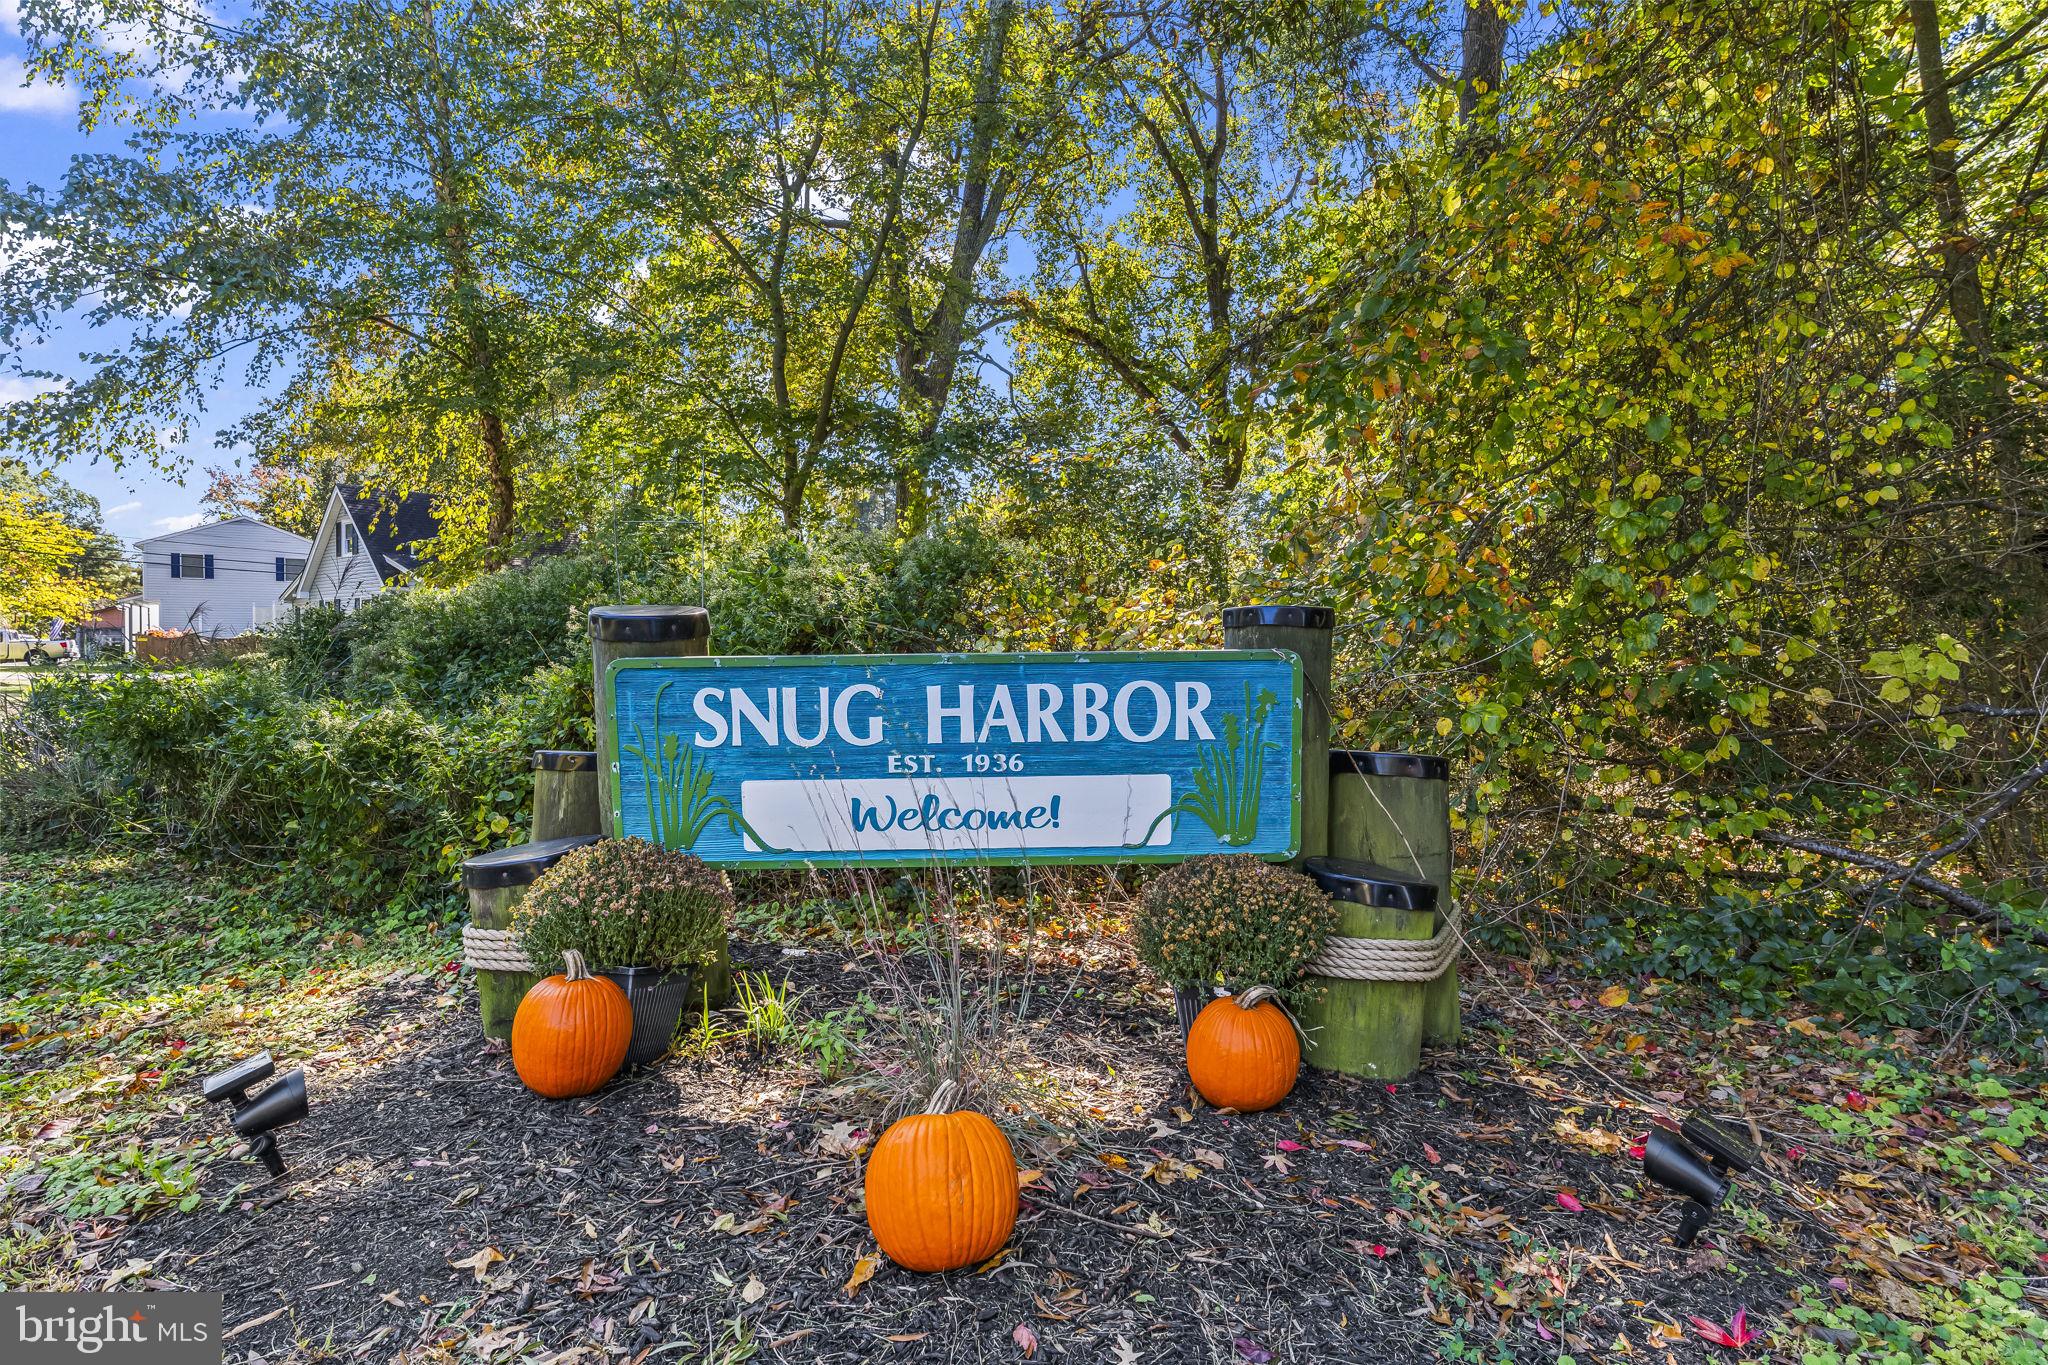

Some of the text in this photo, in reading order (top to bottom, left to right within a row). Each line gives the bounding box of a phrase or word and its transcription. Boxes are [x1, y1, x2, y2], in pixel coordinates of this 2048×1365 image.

[692, 680, 1216, 747] SNUG HARBOR
[887, 753, 1024, 774] EST. 1936
[850, 794, 1061, 832] Welcome!
